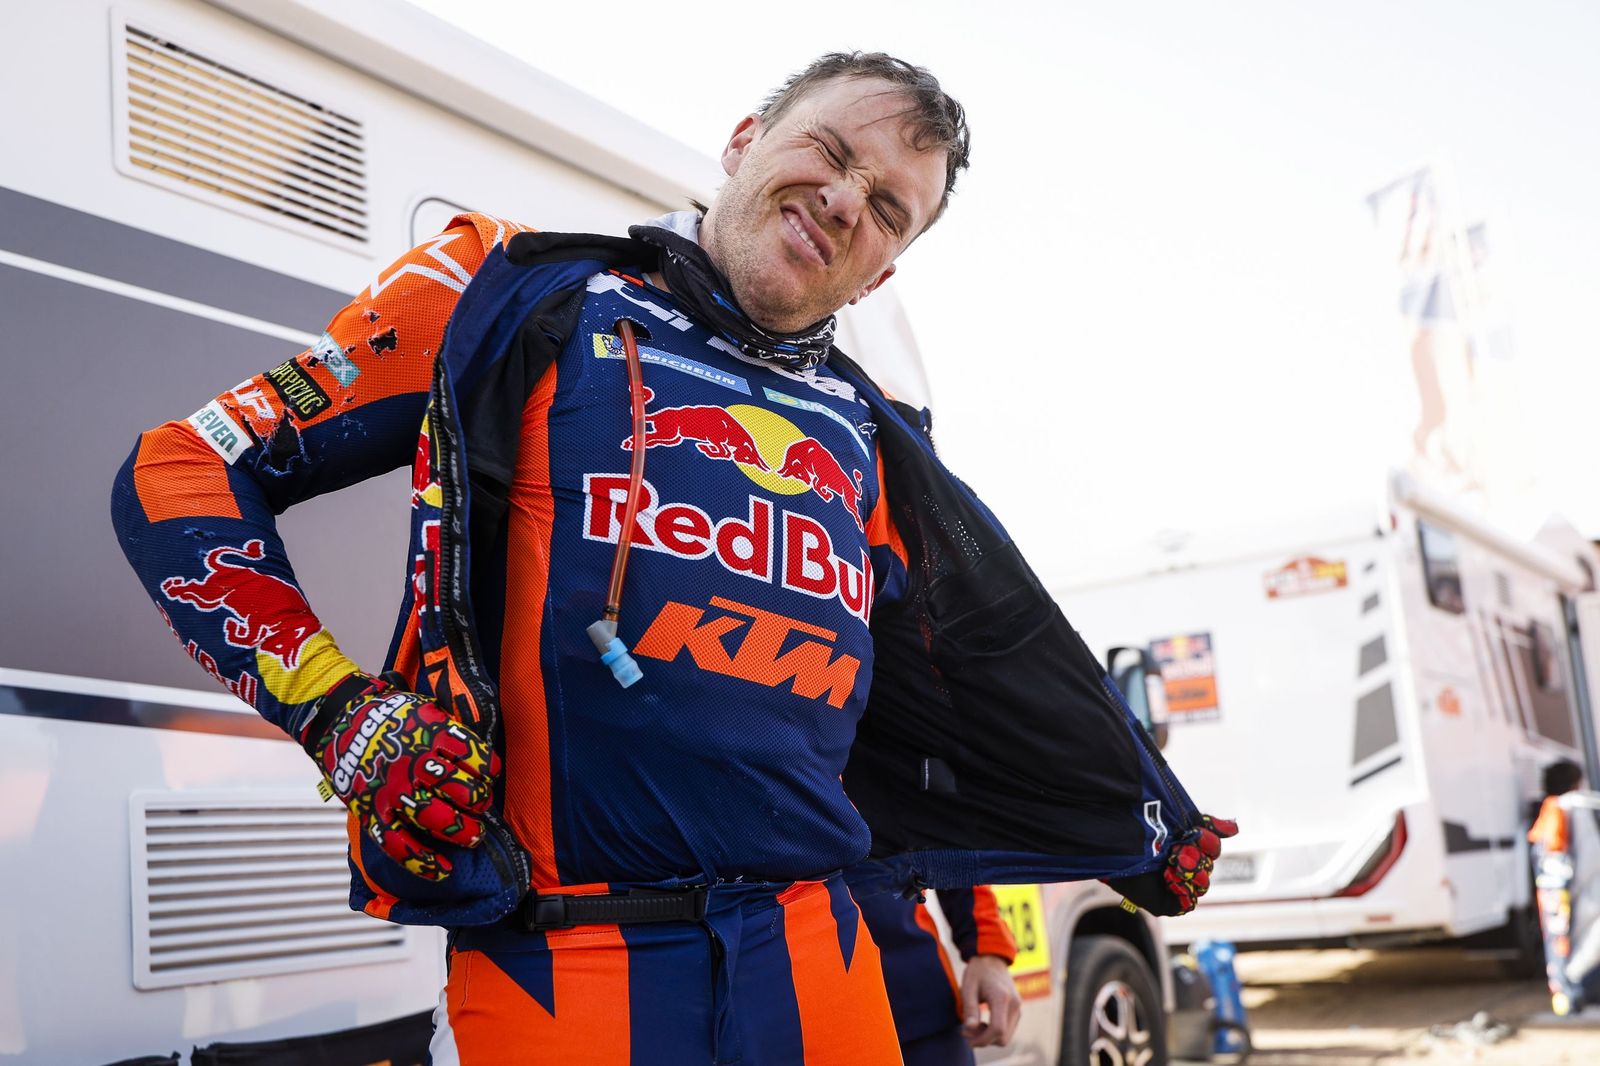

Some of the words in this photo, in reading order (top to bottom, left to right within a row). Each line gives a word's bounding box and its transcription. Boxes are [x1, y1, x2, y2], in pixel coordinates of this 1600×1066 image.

[641, 352, 737, 386] MICHELIN
[583, 472, 774, 584] Red
[632, 595, 861, 710] KTM
[334, 693, 409, 793] Chucky
